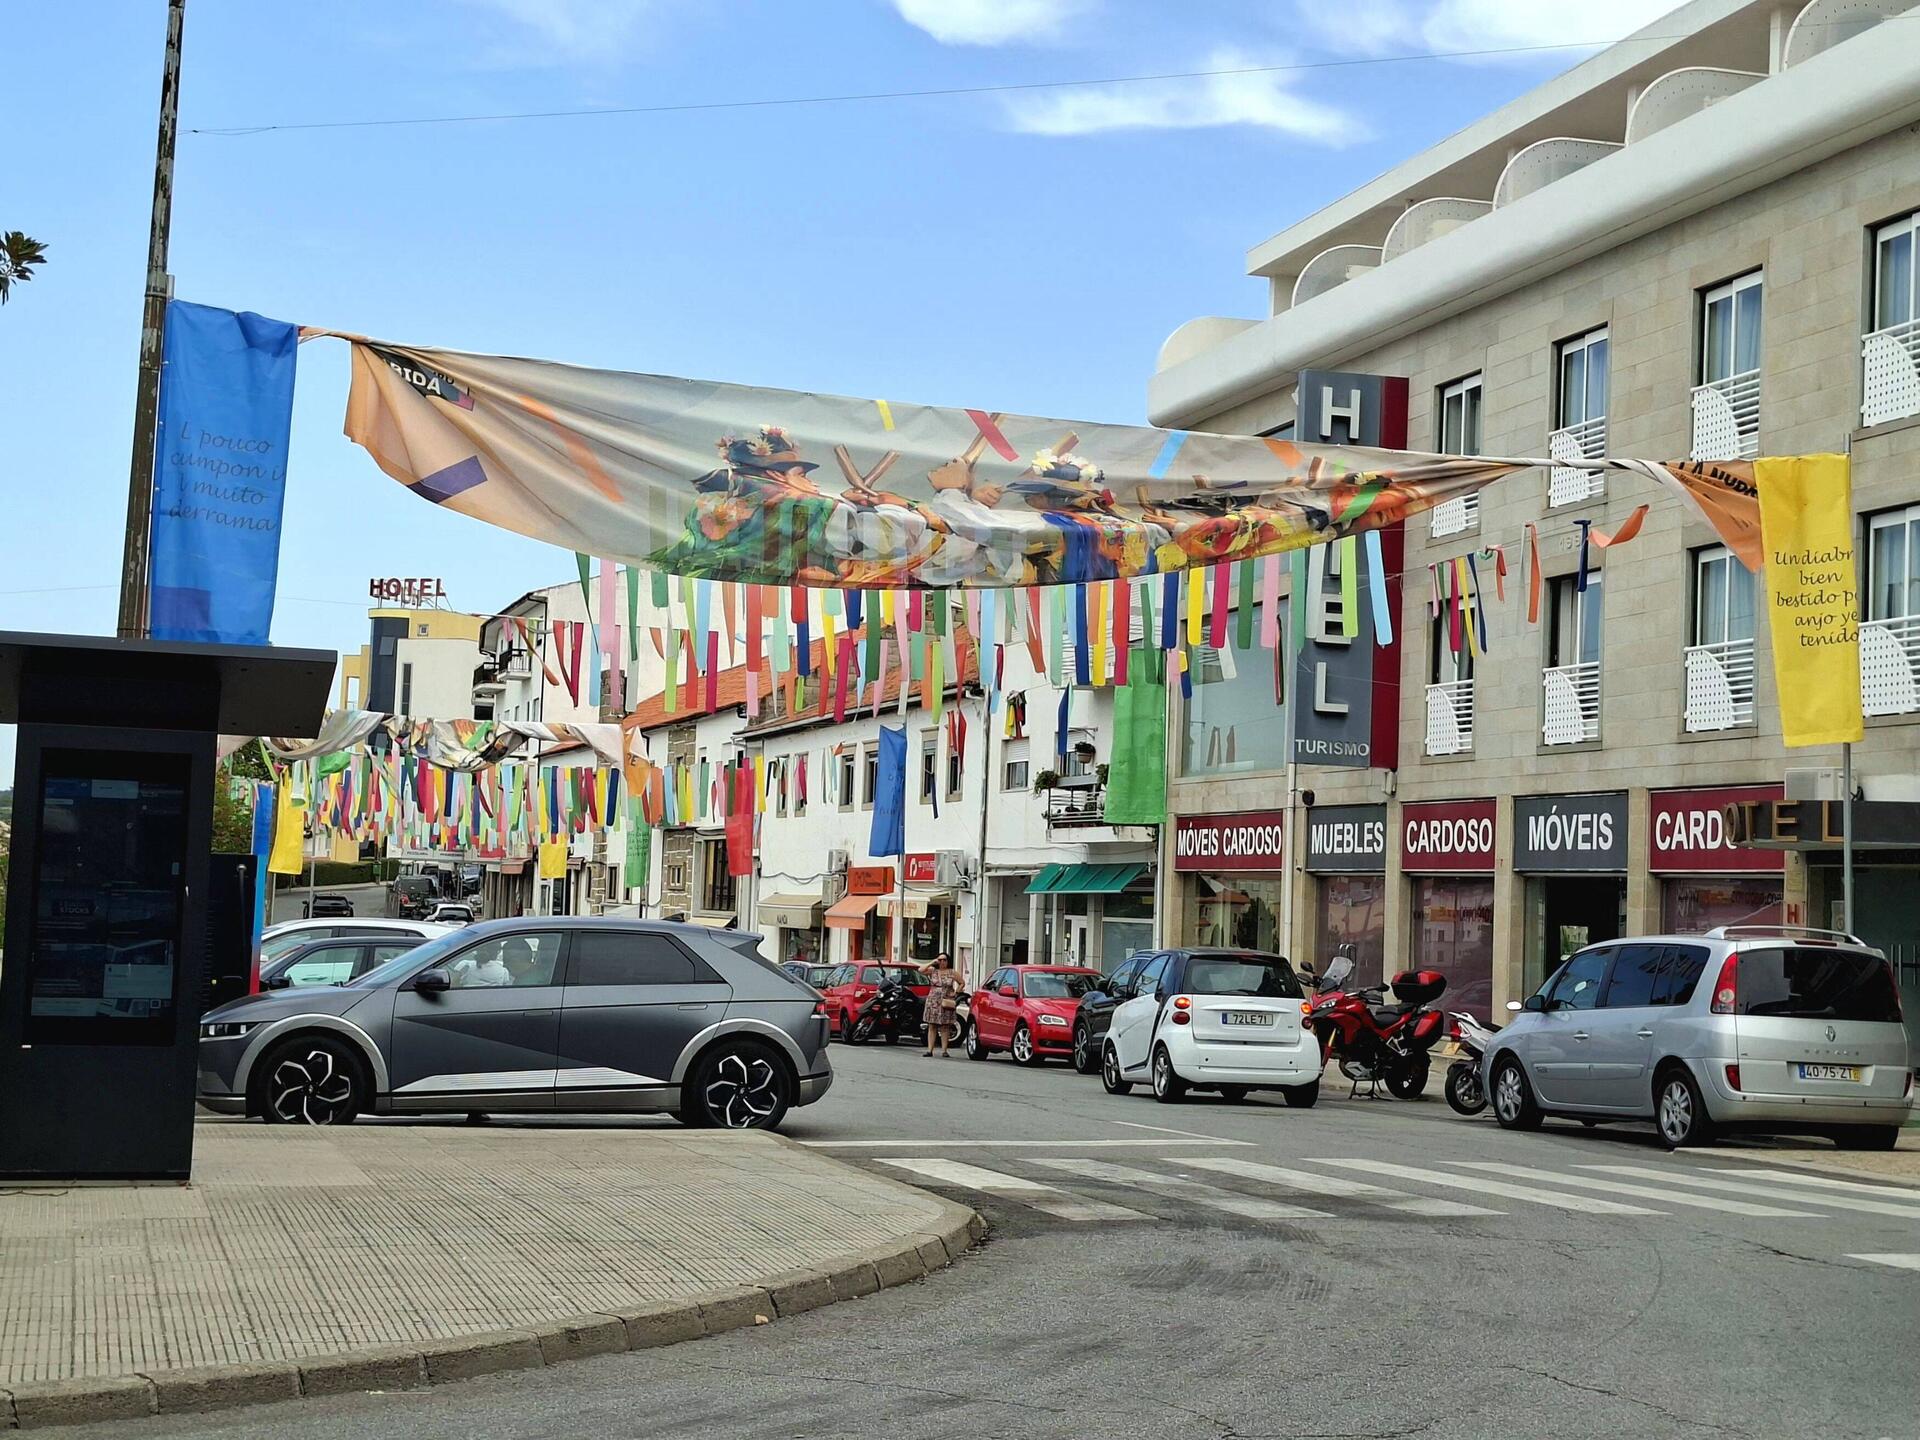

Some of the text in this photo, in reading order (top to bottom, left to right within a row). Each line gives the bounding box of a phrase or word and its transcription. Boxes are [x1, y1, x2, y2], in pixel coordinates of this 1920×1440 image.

[199, 429, 274, 454] pouco
[193, 480, 269, 505] muito
[168, 498, 278, 531] derrama
[369, 578, 446, 597] HOTEL
[1800, 570, 1843, 586] bien
[1776, 589, 1840, 607] bestido
[1795, 612, 1837, 631] anjo
[1295, 739, 1370, 757] TURISMO
[1177, 822, 1282, 857] MÓVEIS CARDOSO
[1311, 821, 1384, 855] MUEBLES
[1406, 818, 1493, 853] CARDOSO
[1528, 805, 1613, 852] MÓVEIS
